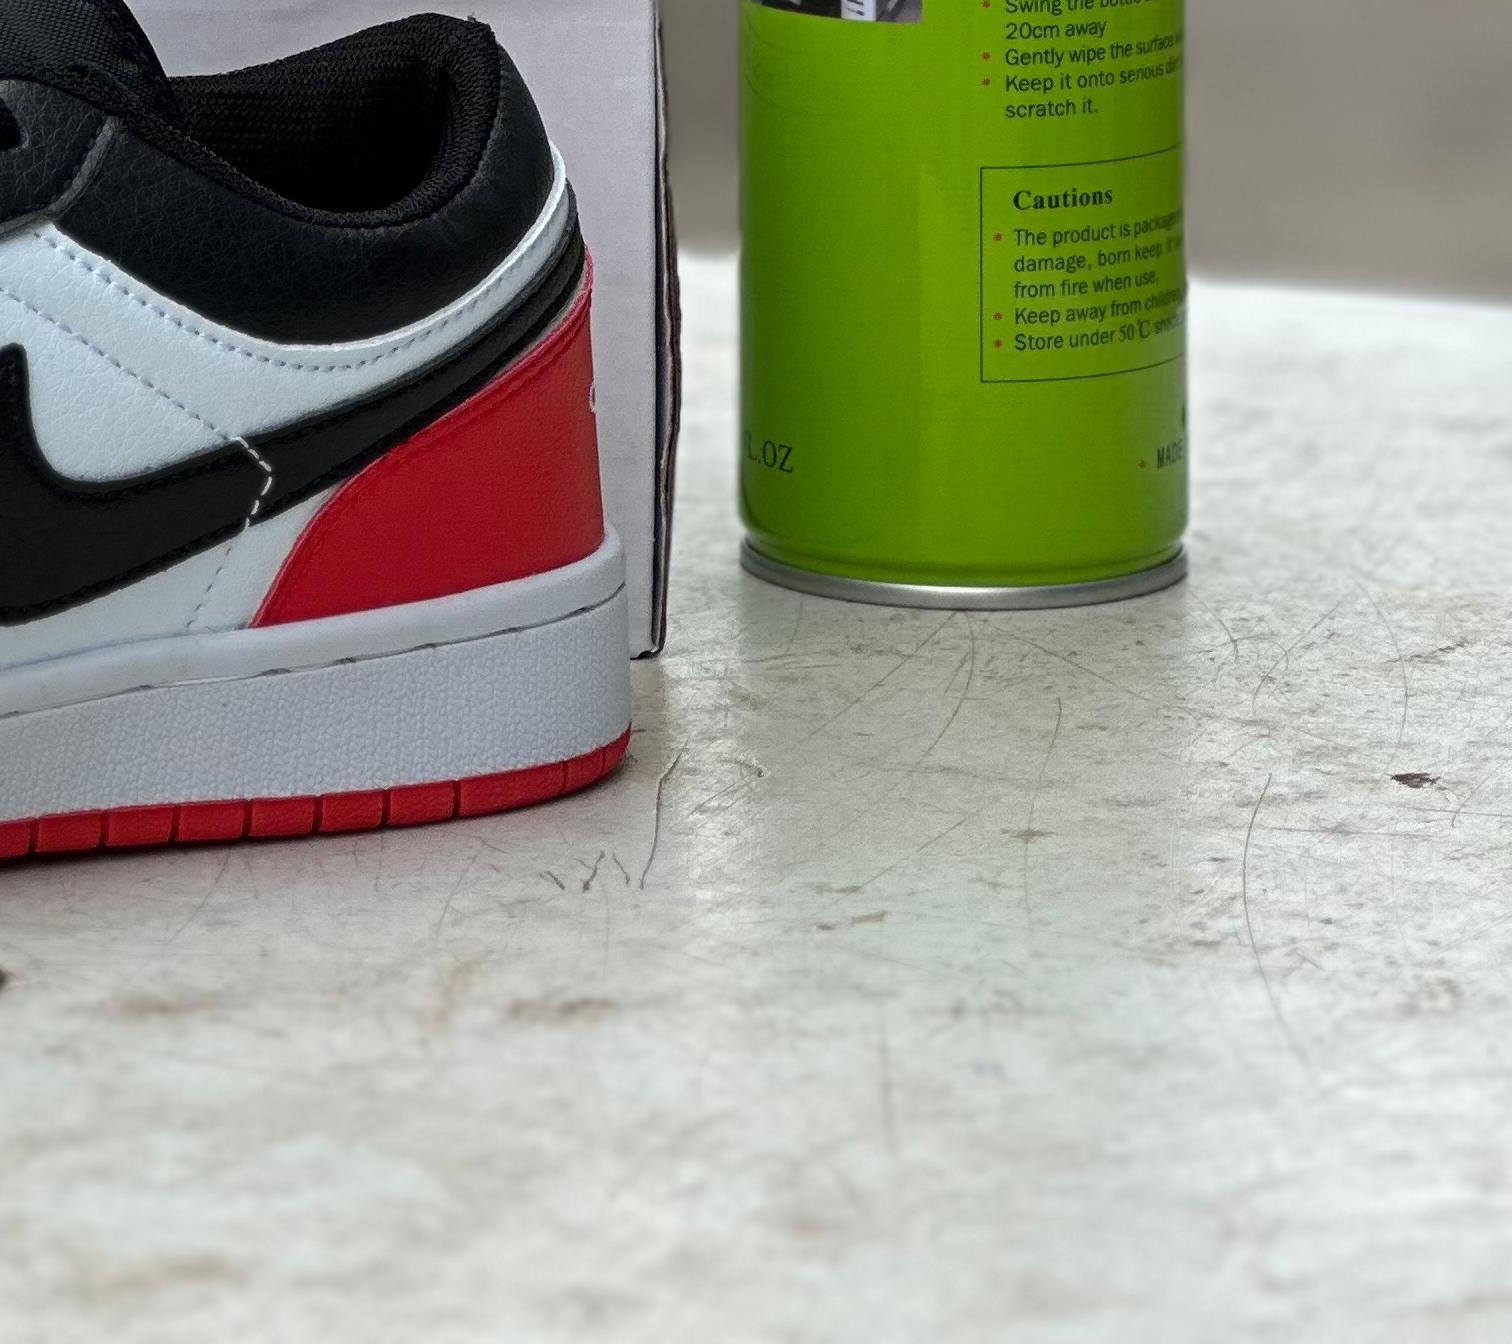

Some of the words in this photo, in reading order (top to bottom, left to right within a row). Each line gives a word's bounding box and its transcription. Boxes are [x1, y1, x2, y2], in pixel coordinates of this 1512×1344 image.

[1005, 21, 1060, 40] 20cm
[1065, 20, 1107, 38] away
[1005, 47, 1064, 68] Gently
[1069, 45, 1105, 64] wipe
[1110, 41, 1133, 60] the
[1005, 75, 1054, 94] Keep
[1060, 73, 1072, 90] it
[1077, 71, 1114, 88] onto
[1005, 98, 1076, 118] scratch
[1082, 97, 1099, 114] it.
[1012, 187, 1113, 211] Cautions
[1013, 228, 1047, 247] The
[1052, 224, 1115, 248] product
[1119, 223, 1130, 238] is
[1013, 254, 1092, 273] damage,
[1013, 280, 1055, 299] from
[1061, 278, 1088, 296] fire
[1093, 274, 1131, 293] when
[1014, 307, 1061, 326] Keep
[1066, 303, 1106, 323] away
[1111, 298, 1141, 317] from
[1014, 333, 1064, 352] Store
[1069, 327, 1115, 348] under
